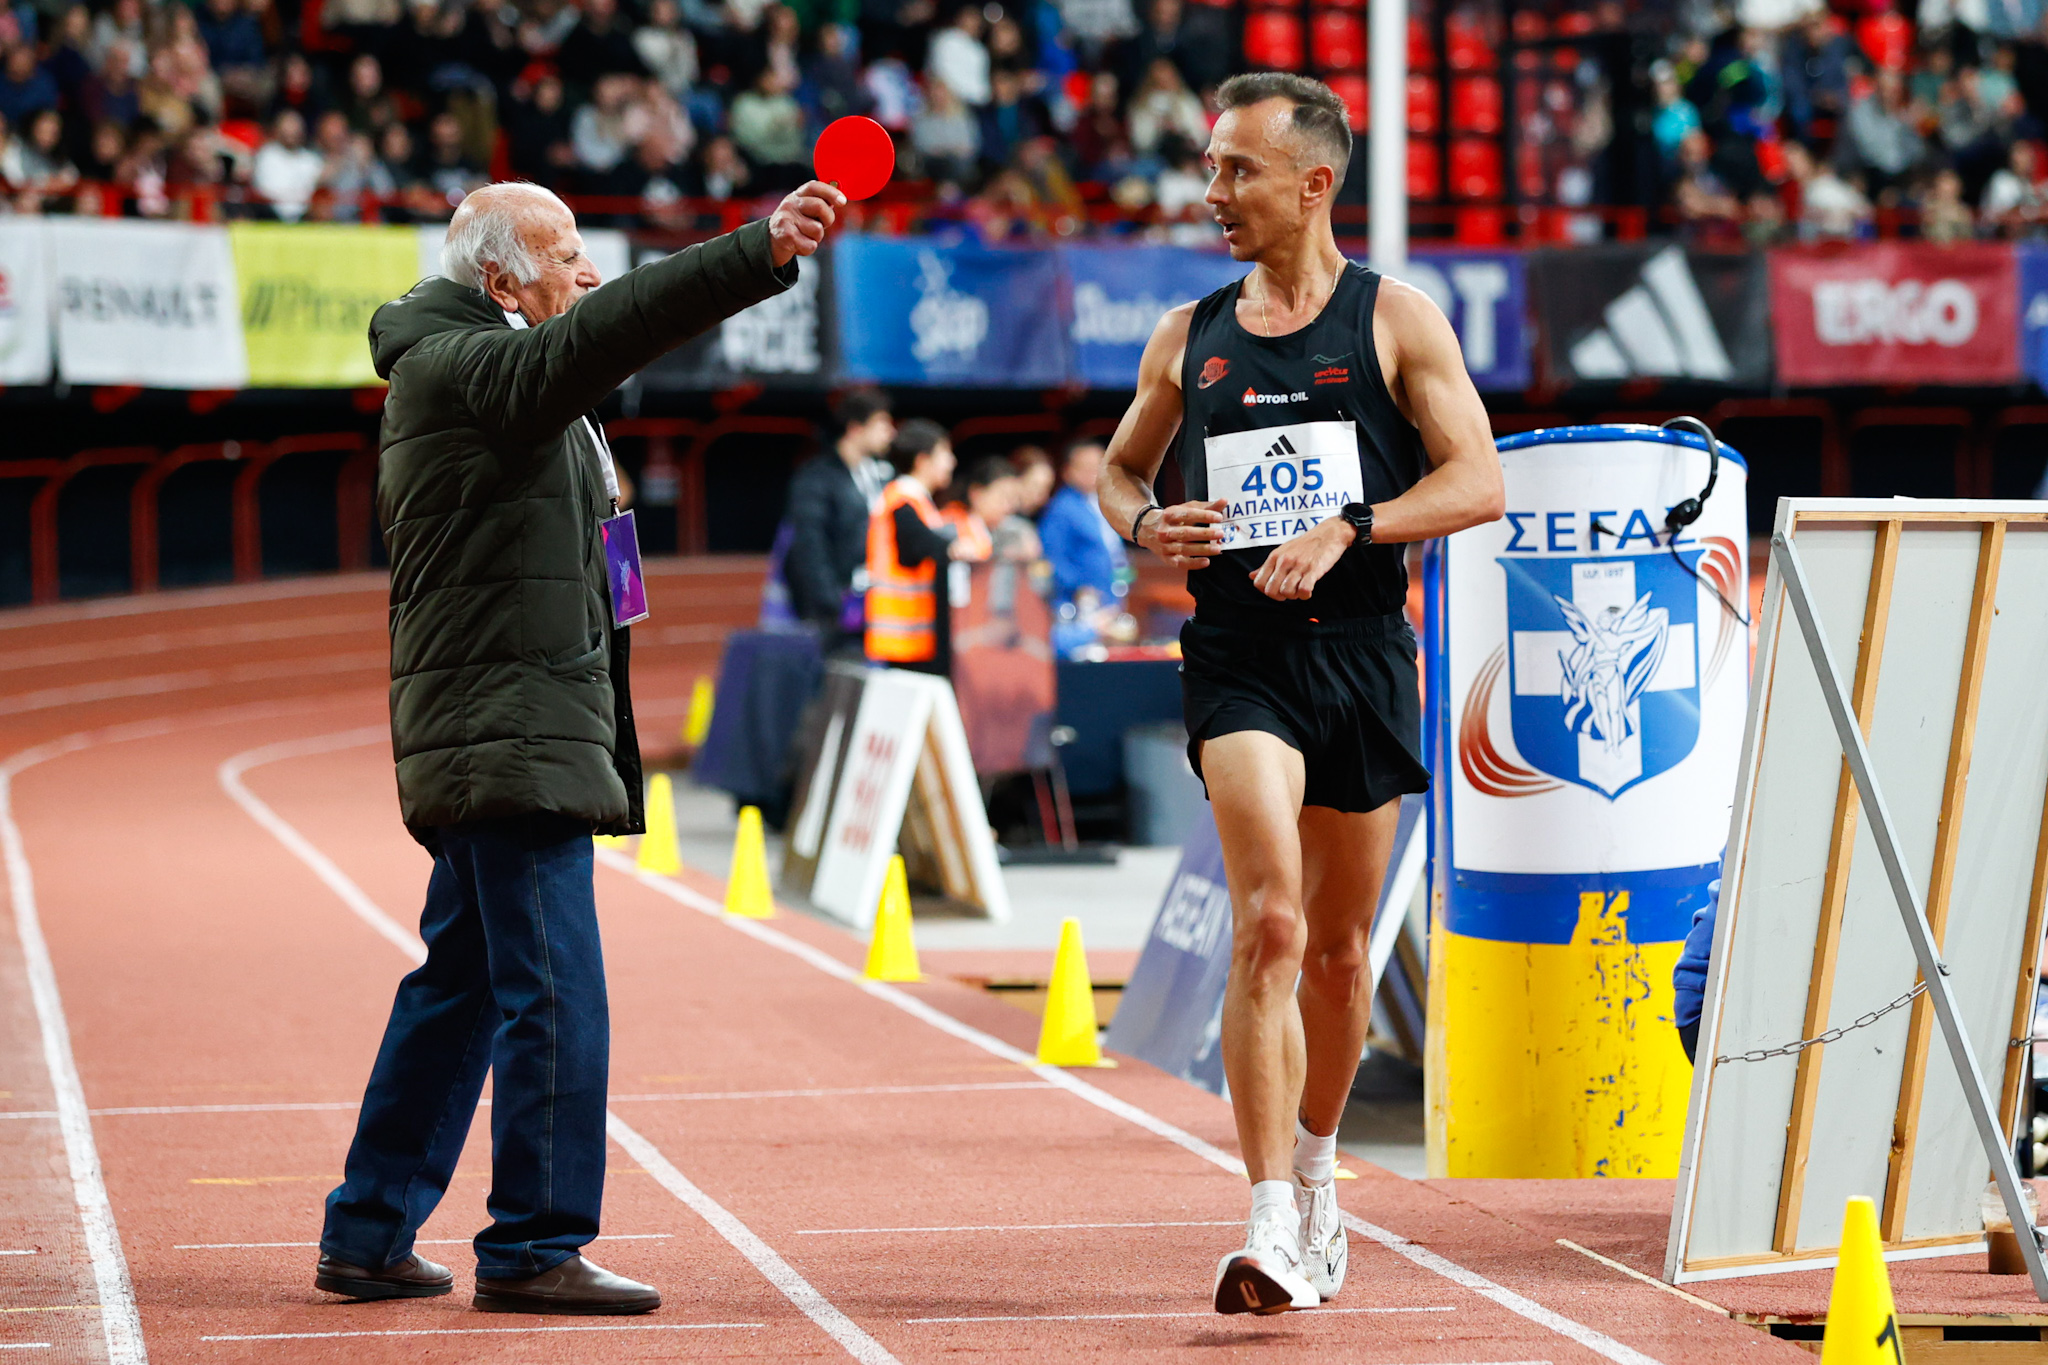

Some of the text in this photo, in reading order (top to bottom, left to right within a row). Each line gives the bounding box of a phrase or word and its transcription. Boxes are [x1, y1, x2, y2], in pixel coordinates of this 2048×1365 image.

[1812, 279, 1978, 347] ERGO
[1243, 391, 1309, 405] MOTOR OIL
[1241, 458, 1324, 497] 405
